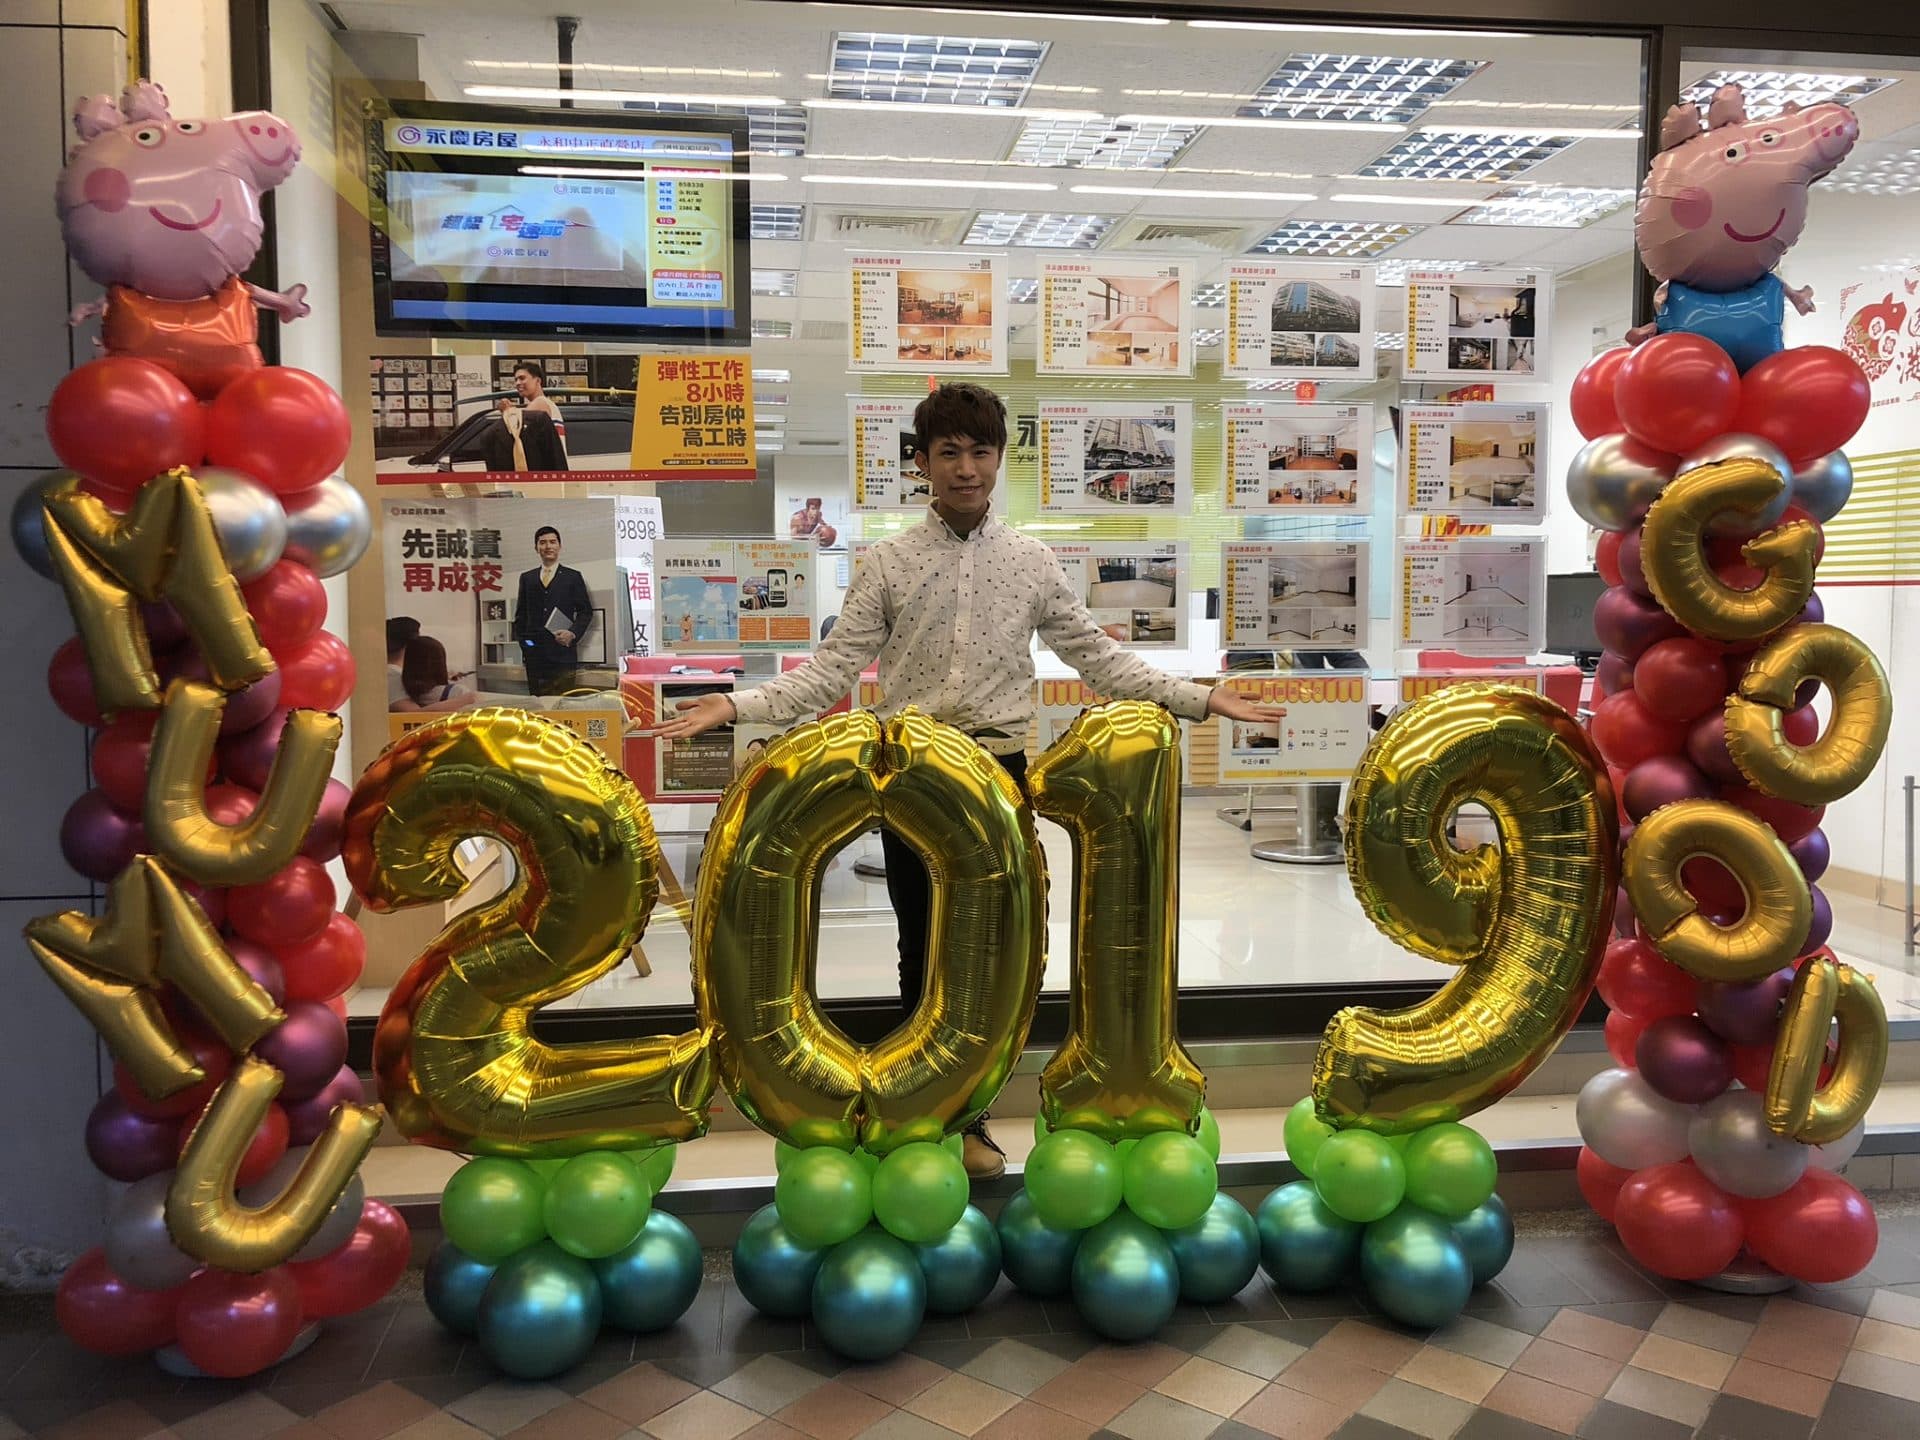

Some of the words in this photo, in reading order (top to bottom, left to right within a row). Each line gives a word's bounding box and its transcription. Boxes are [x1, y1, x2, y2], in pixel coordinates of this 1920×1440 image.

[426, 129, 518, 148] 永慶房屋
[657, 360, 744, 382] 彈性工作
[686, 383, 745, 403] 8小時
[659, 404, 746, 427] 告別房仲
[682, 426, 747, 448] 高工時
[402, 528, 502, 560] 先誠實
[403, 562, 504, 592] 再成交
[630, 570, 653, 601] 福
[1623, 456, 1891, 1145] GOOD
[344, 682, 1620, 1158] 2019
